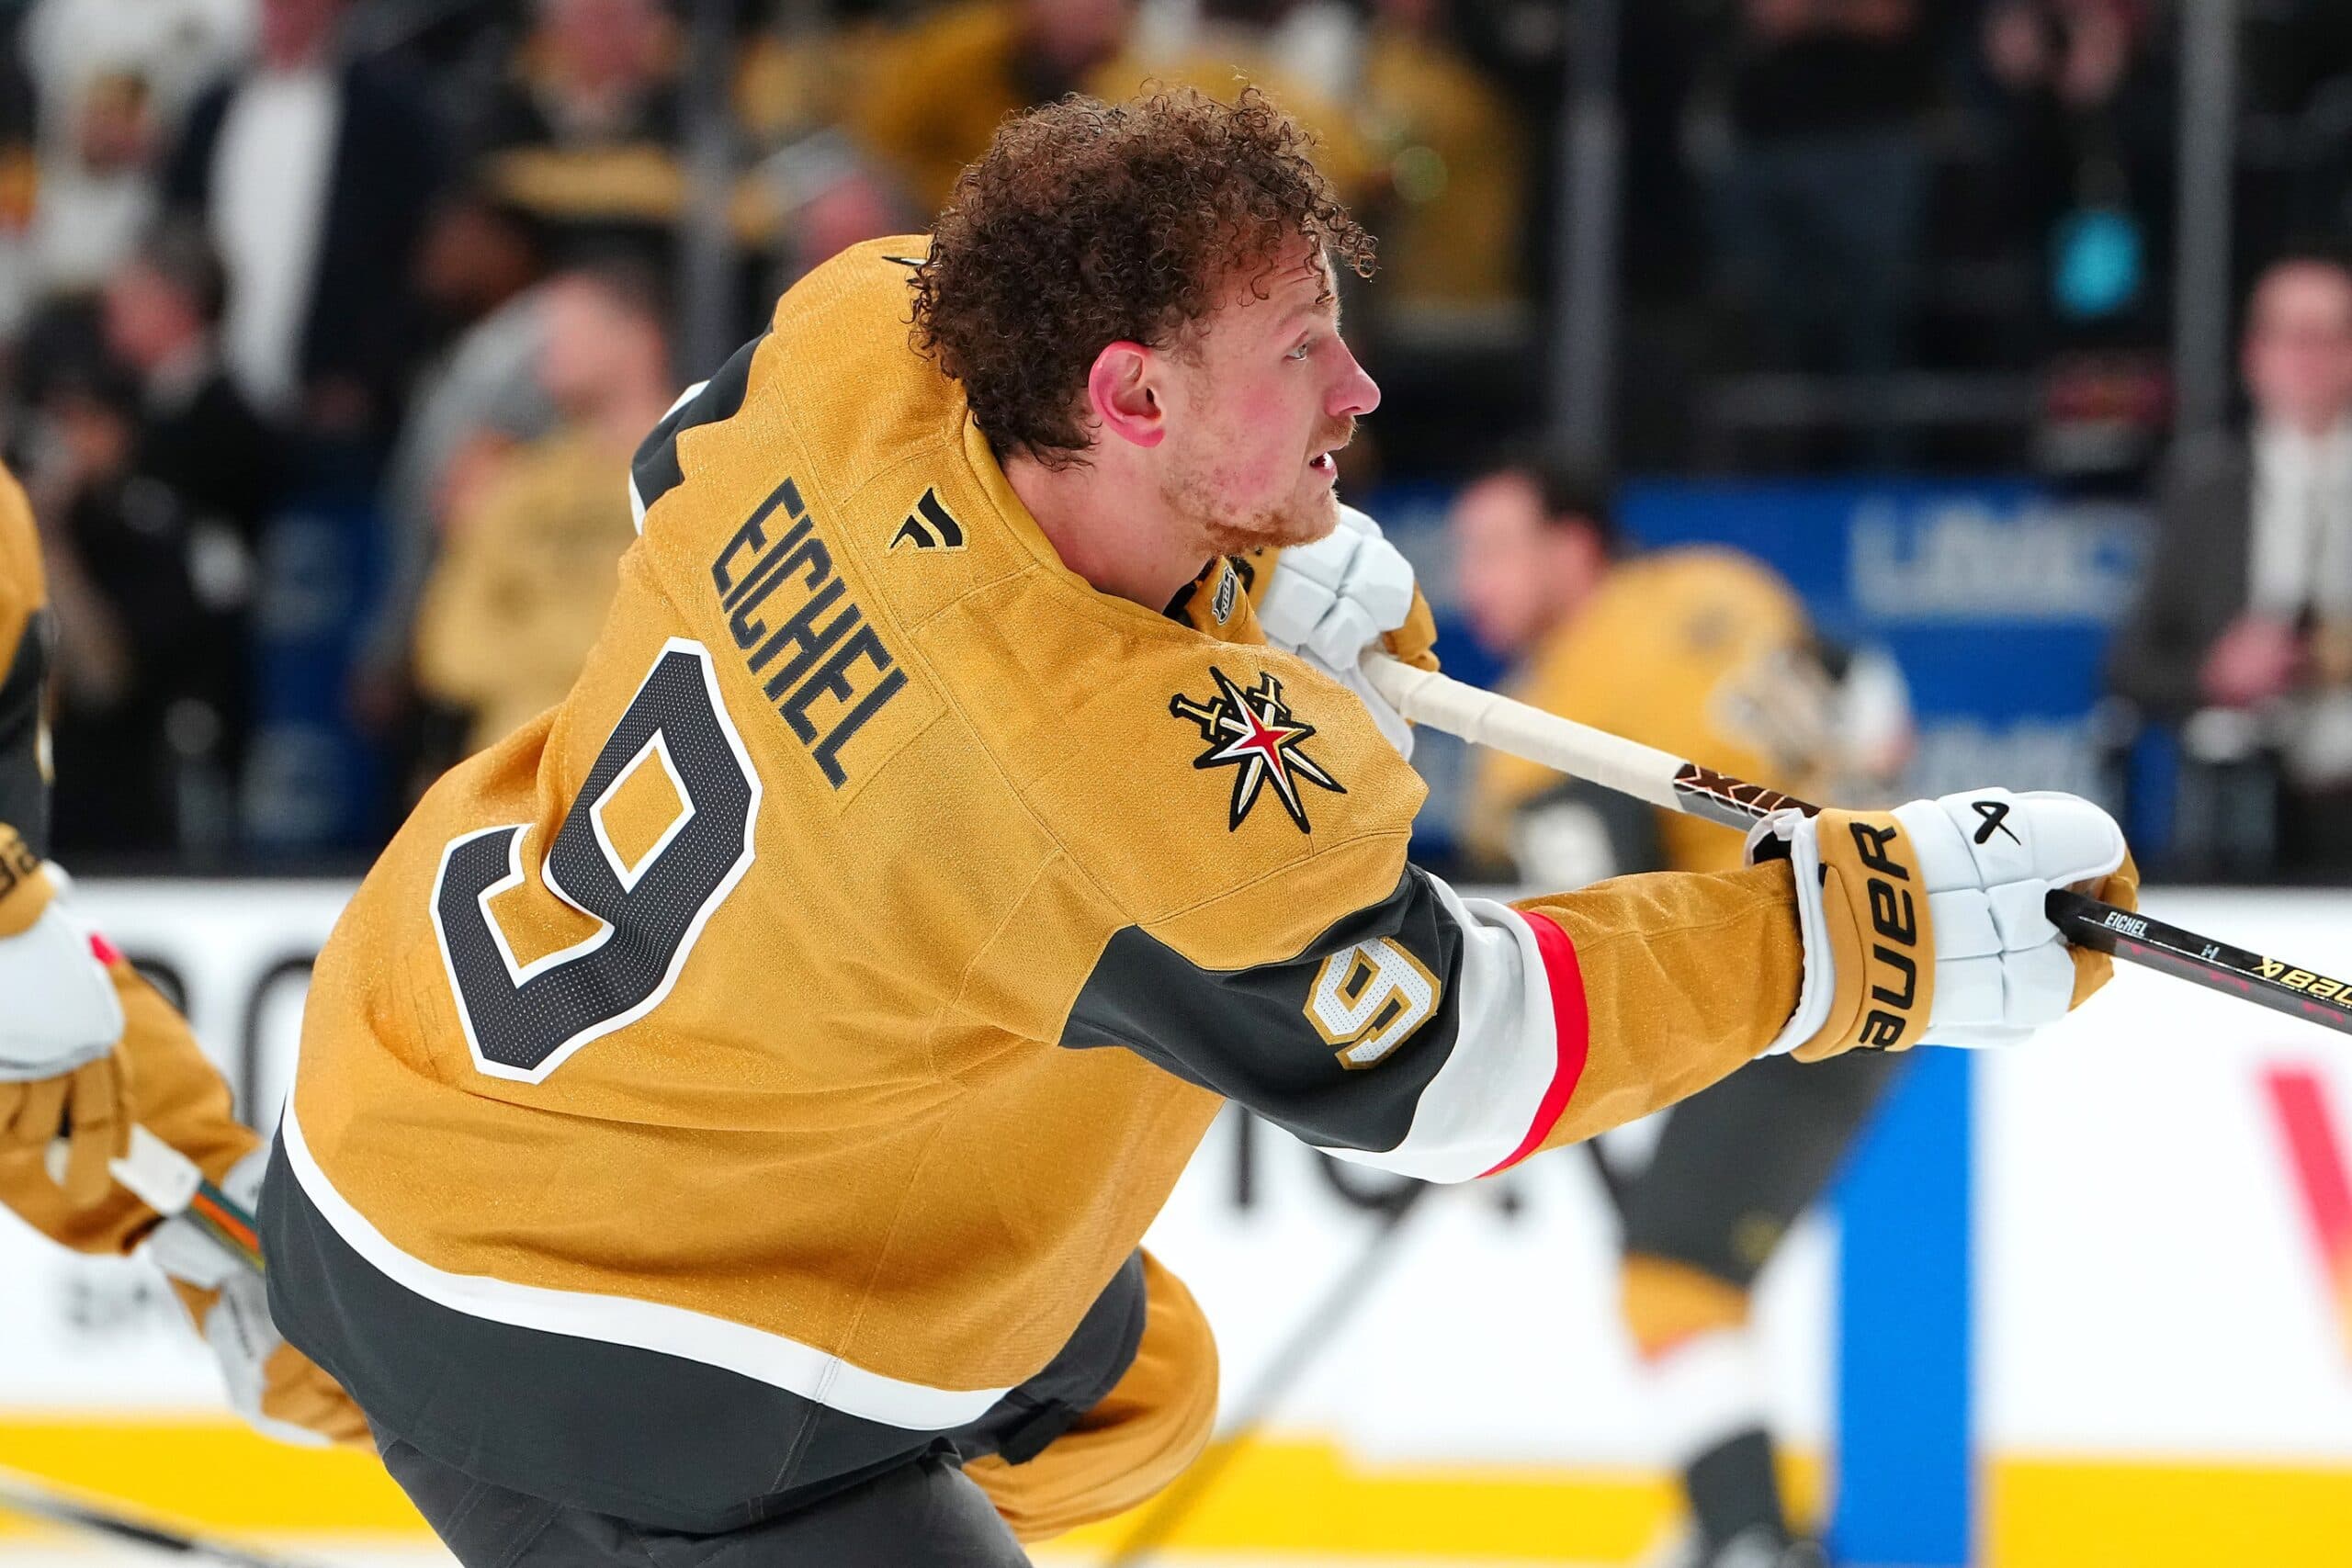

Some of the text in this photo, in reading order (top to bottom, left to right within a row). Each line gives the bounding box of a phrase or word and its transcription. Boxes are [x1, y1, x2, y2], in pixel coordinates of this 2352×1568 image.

[710, 476, 909, 791] EICHEL
[429, 636, 763, 1085] 9
[1849, 822, 1917, 1050] AUER
[2104, 910, 2149, 938] EICHEL
[1302, 936, 1442, 1071] 9
